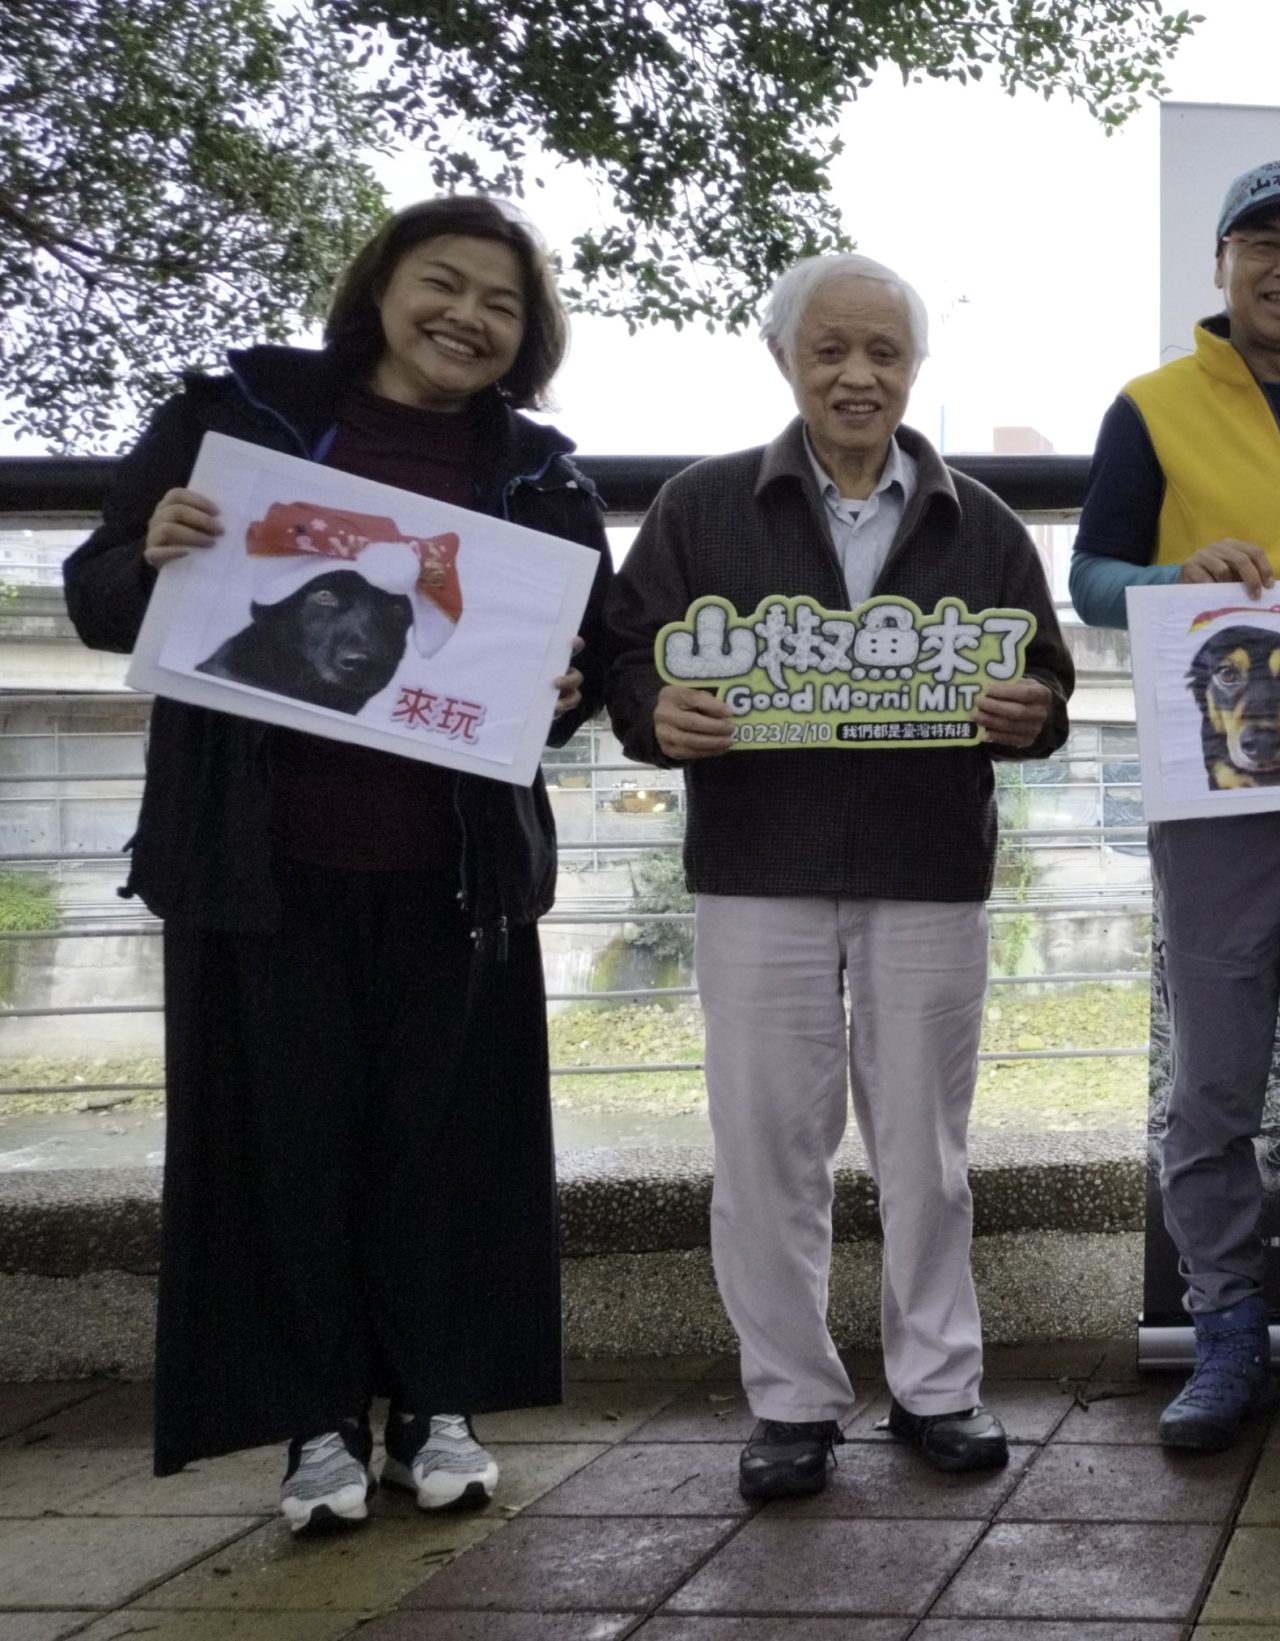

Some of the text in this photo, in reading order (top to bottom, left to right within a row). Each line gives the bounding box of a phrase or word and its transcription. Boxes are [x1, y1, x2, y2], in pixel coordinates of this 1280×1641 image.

[393, 687, 483, 739] 來玩
[725, 682, 982, 716] Good Morni MIT
[731, 722, 832, 745] 2023/2/10
